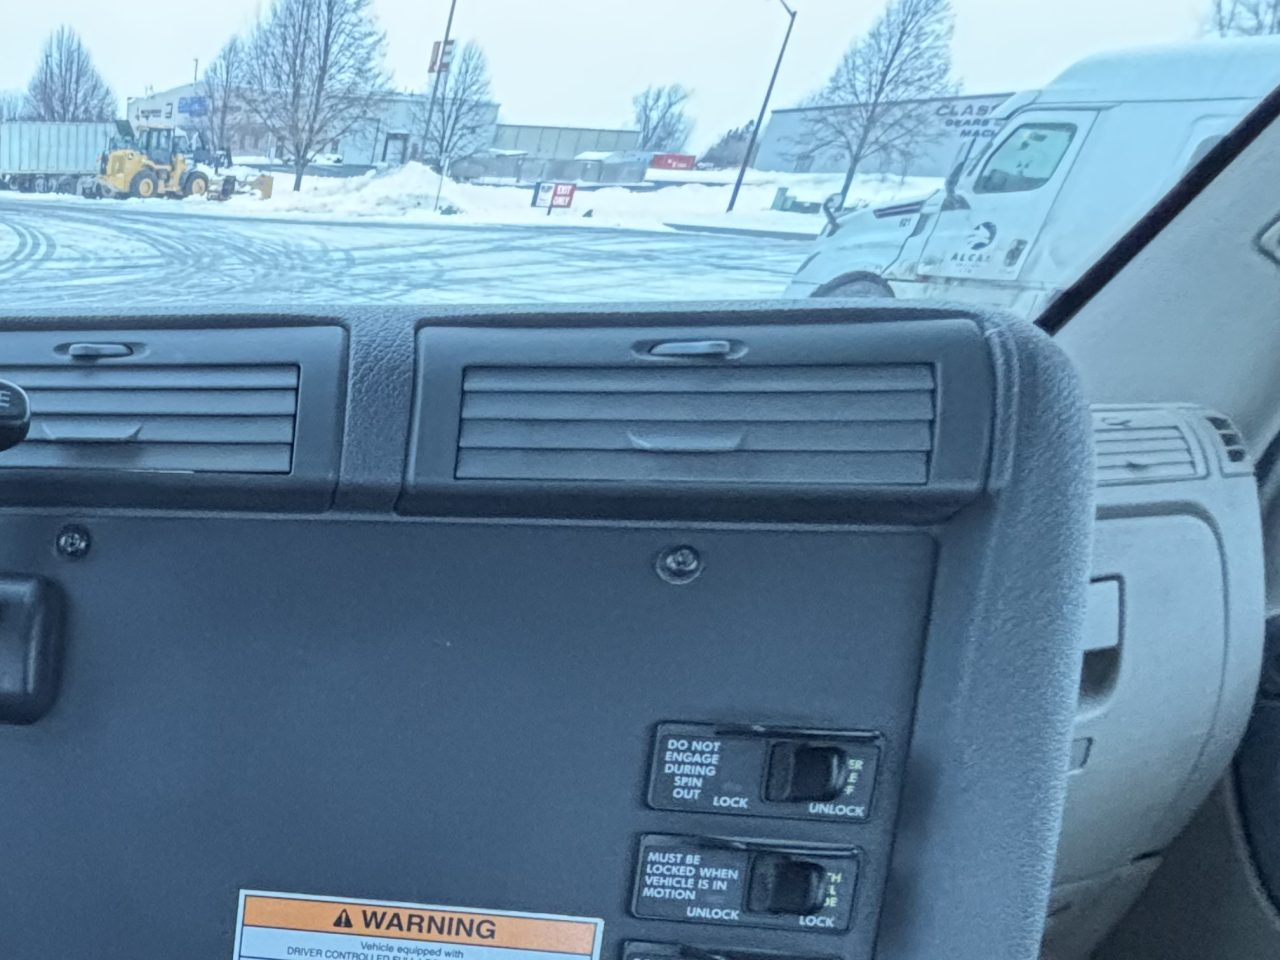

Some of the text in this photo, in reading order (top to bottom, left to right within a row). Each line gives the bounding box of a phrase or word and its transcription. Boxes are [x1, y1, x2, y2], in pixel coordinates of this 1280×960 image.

[667, 739, 721, 752] DO NOT
[664, 751, 719, 765] ENGAGE
[664, 764, 716, 777] DURING
[673, 776, 703, 788] SPIN
[672, 787, 702, 800] OUT
[712, 796, 748, 809] LOCK
[809, 802, 865, 817] UNLOCK
[647, 851, 701, 865] MUST BE
[646, 864, 739, 880] LOCKED WHEN
[644, 875, 727, 890] VEHICLE IS IN
[642, 887, 696, 900] MOTION
[686, 906, 739, 920] UNLOCK
[361, 909, 497, 939] WARNING
[799, 915, 835, 928] LOCK
[287, 946, 323, 958] DRIVER
[360, 941, 464, 959] Vehicle equipped with
